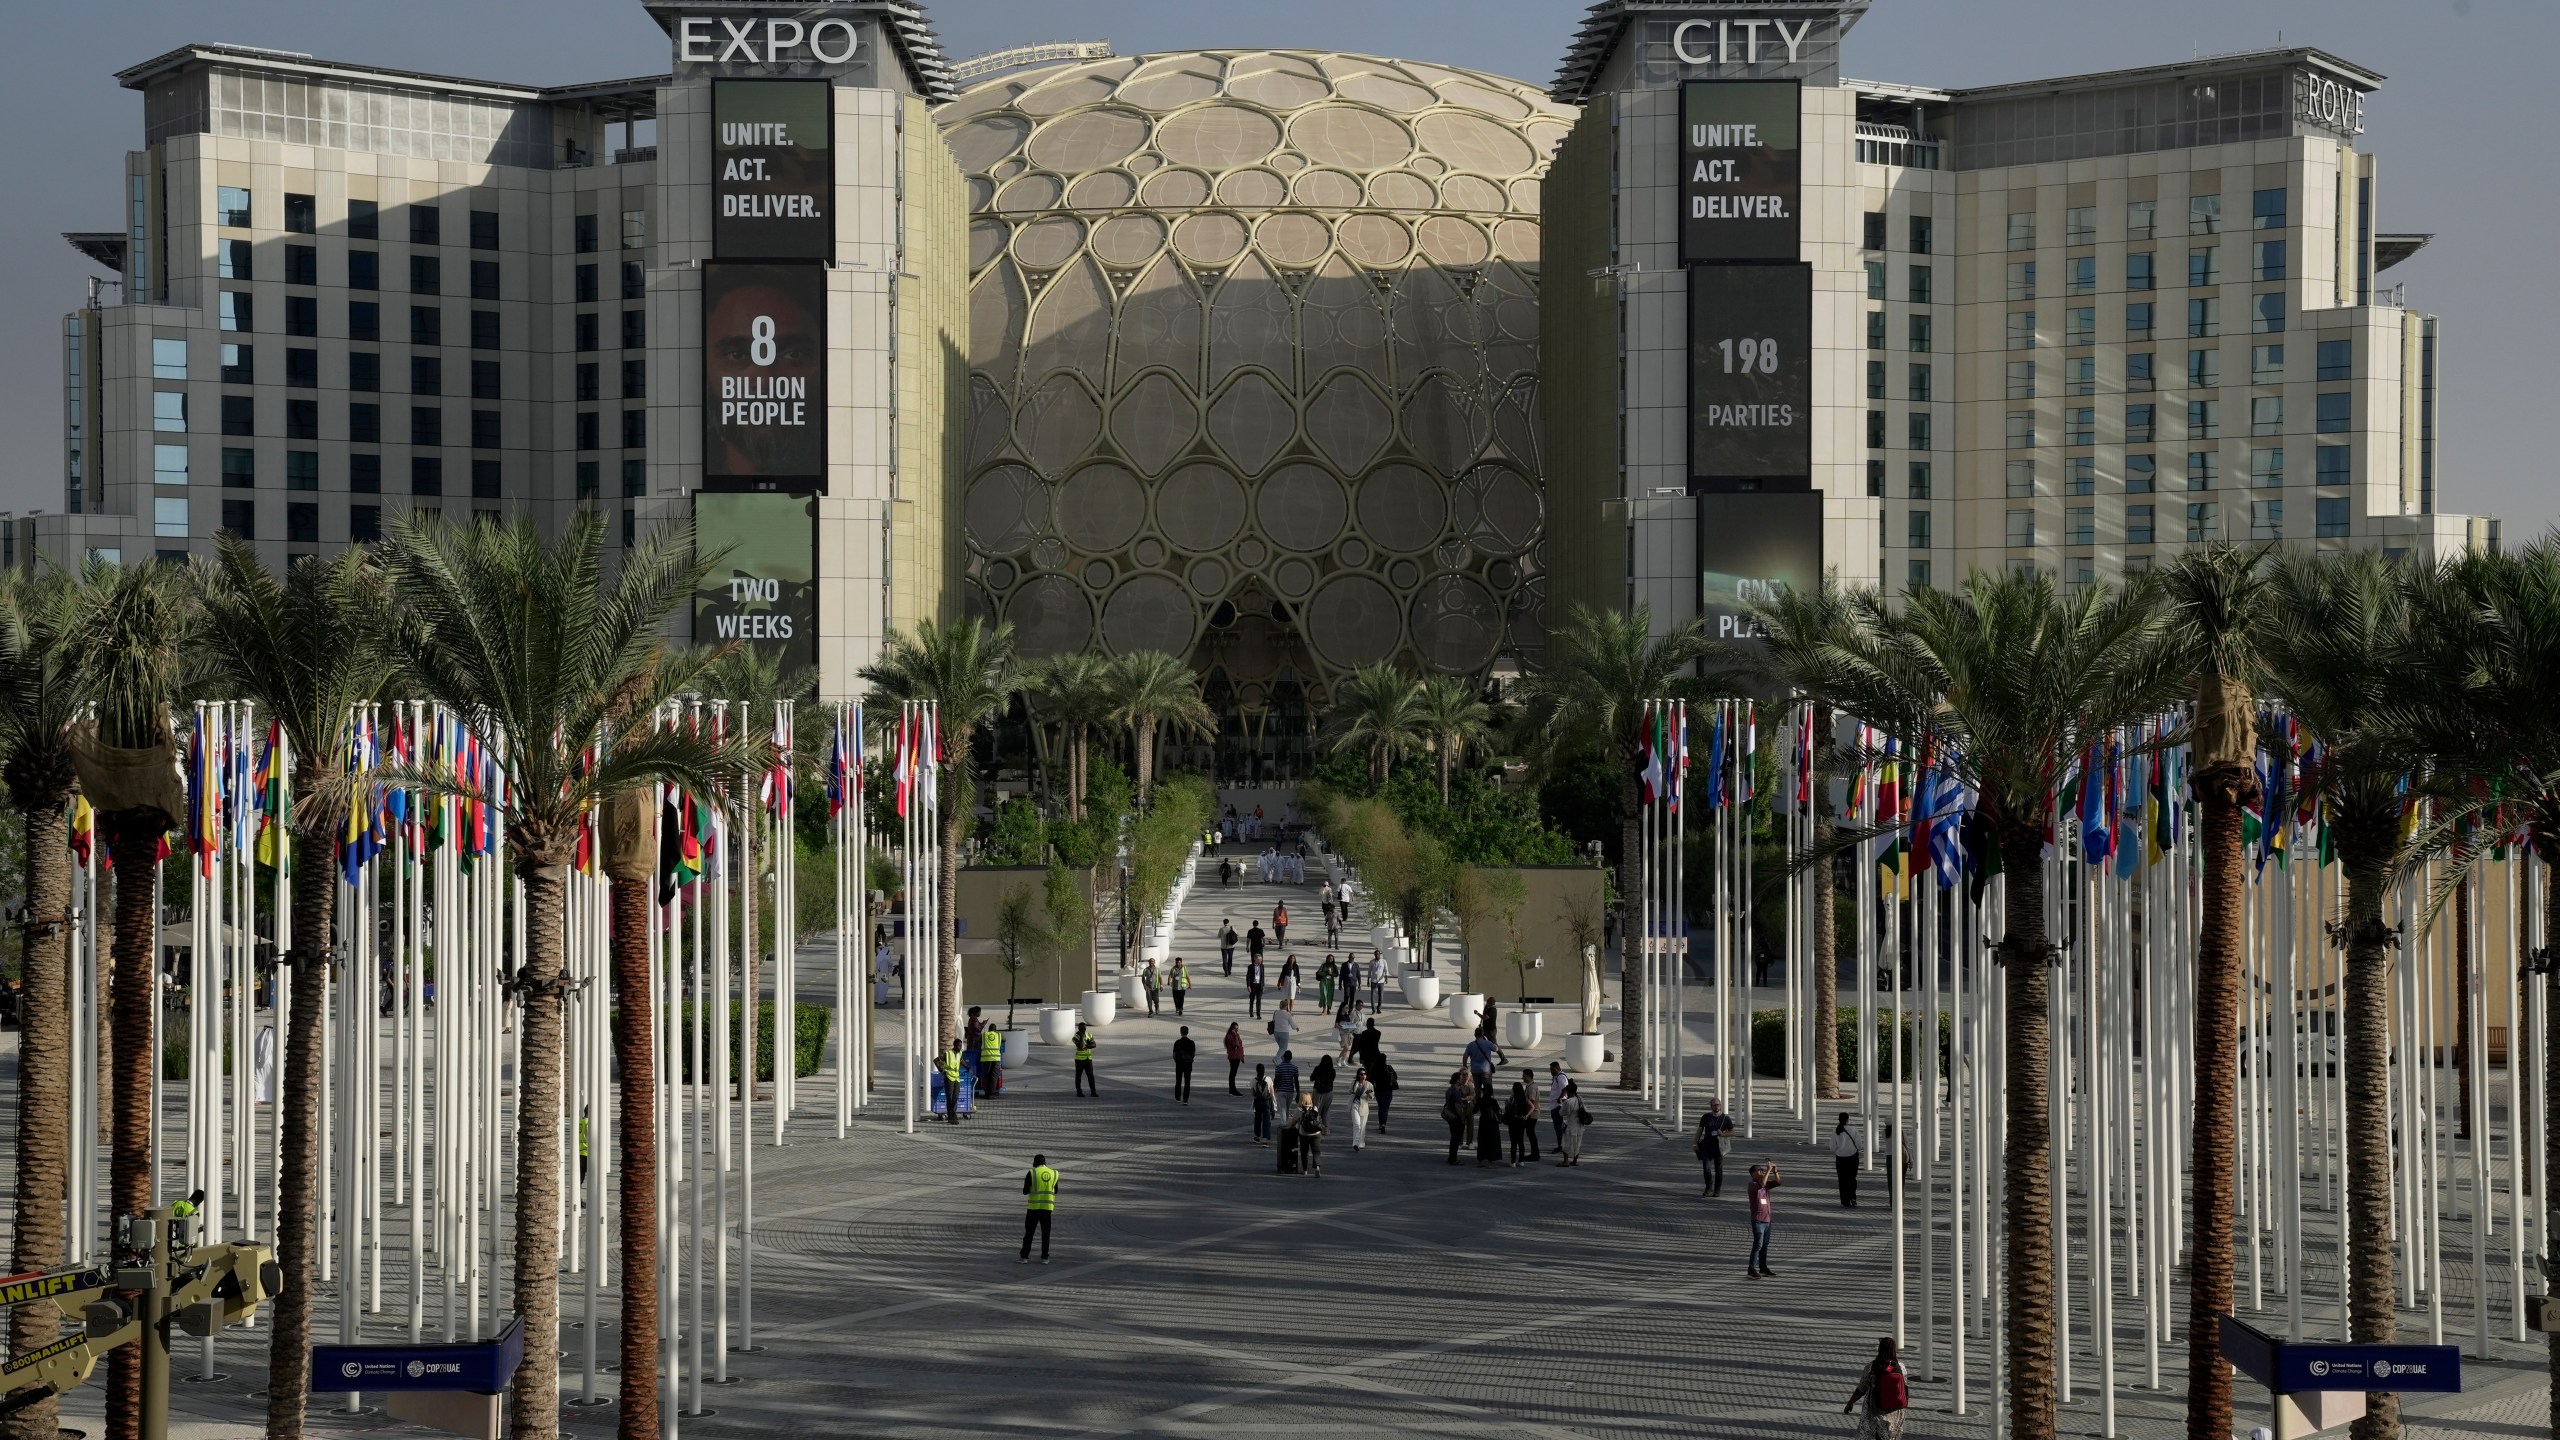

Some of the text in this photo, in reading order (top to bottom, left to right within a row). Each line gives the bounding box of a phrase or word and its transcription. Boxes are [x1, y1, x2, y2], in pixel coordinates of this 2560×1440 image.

[680, 17, 858, 64] EXPO
[1673, 18, 1813, 65] CITY
[2307, 72, 2365, 134] ROVE
[722, 122, 794, 146] UNITE.
[1692, 124, 1763, 147] UNITE.
[723, 158, 771, 181] ACT.
[1692, 159, 1740, 183] ACT.
[723, 194, 821, 218] DELIVER.
[1692, 195, 1790, 219] DELIVER.
[750, 315, 777, 366] 8
[1718, 337, 1779, 374] 198
[721, 376, 805, 399] BILLION
[722, 401, 806, 426] PEOPLE
[1708, 404, 1793, 427] PARTIES
[728, 578, 780, 602] TWO
[715, 615, 793, 639] WEEKS
[12, 1333, 85, 1370] 800MANLIFT
[426, 1363, 460, 1372] COP28UAE
[2392, 1364, 2427, 1374] COP28UAE
